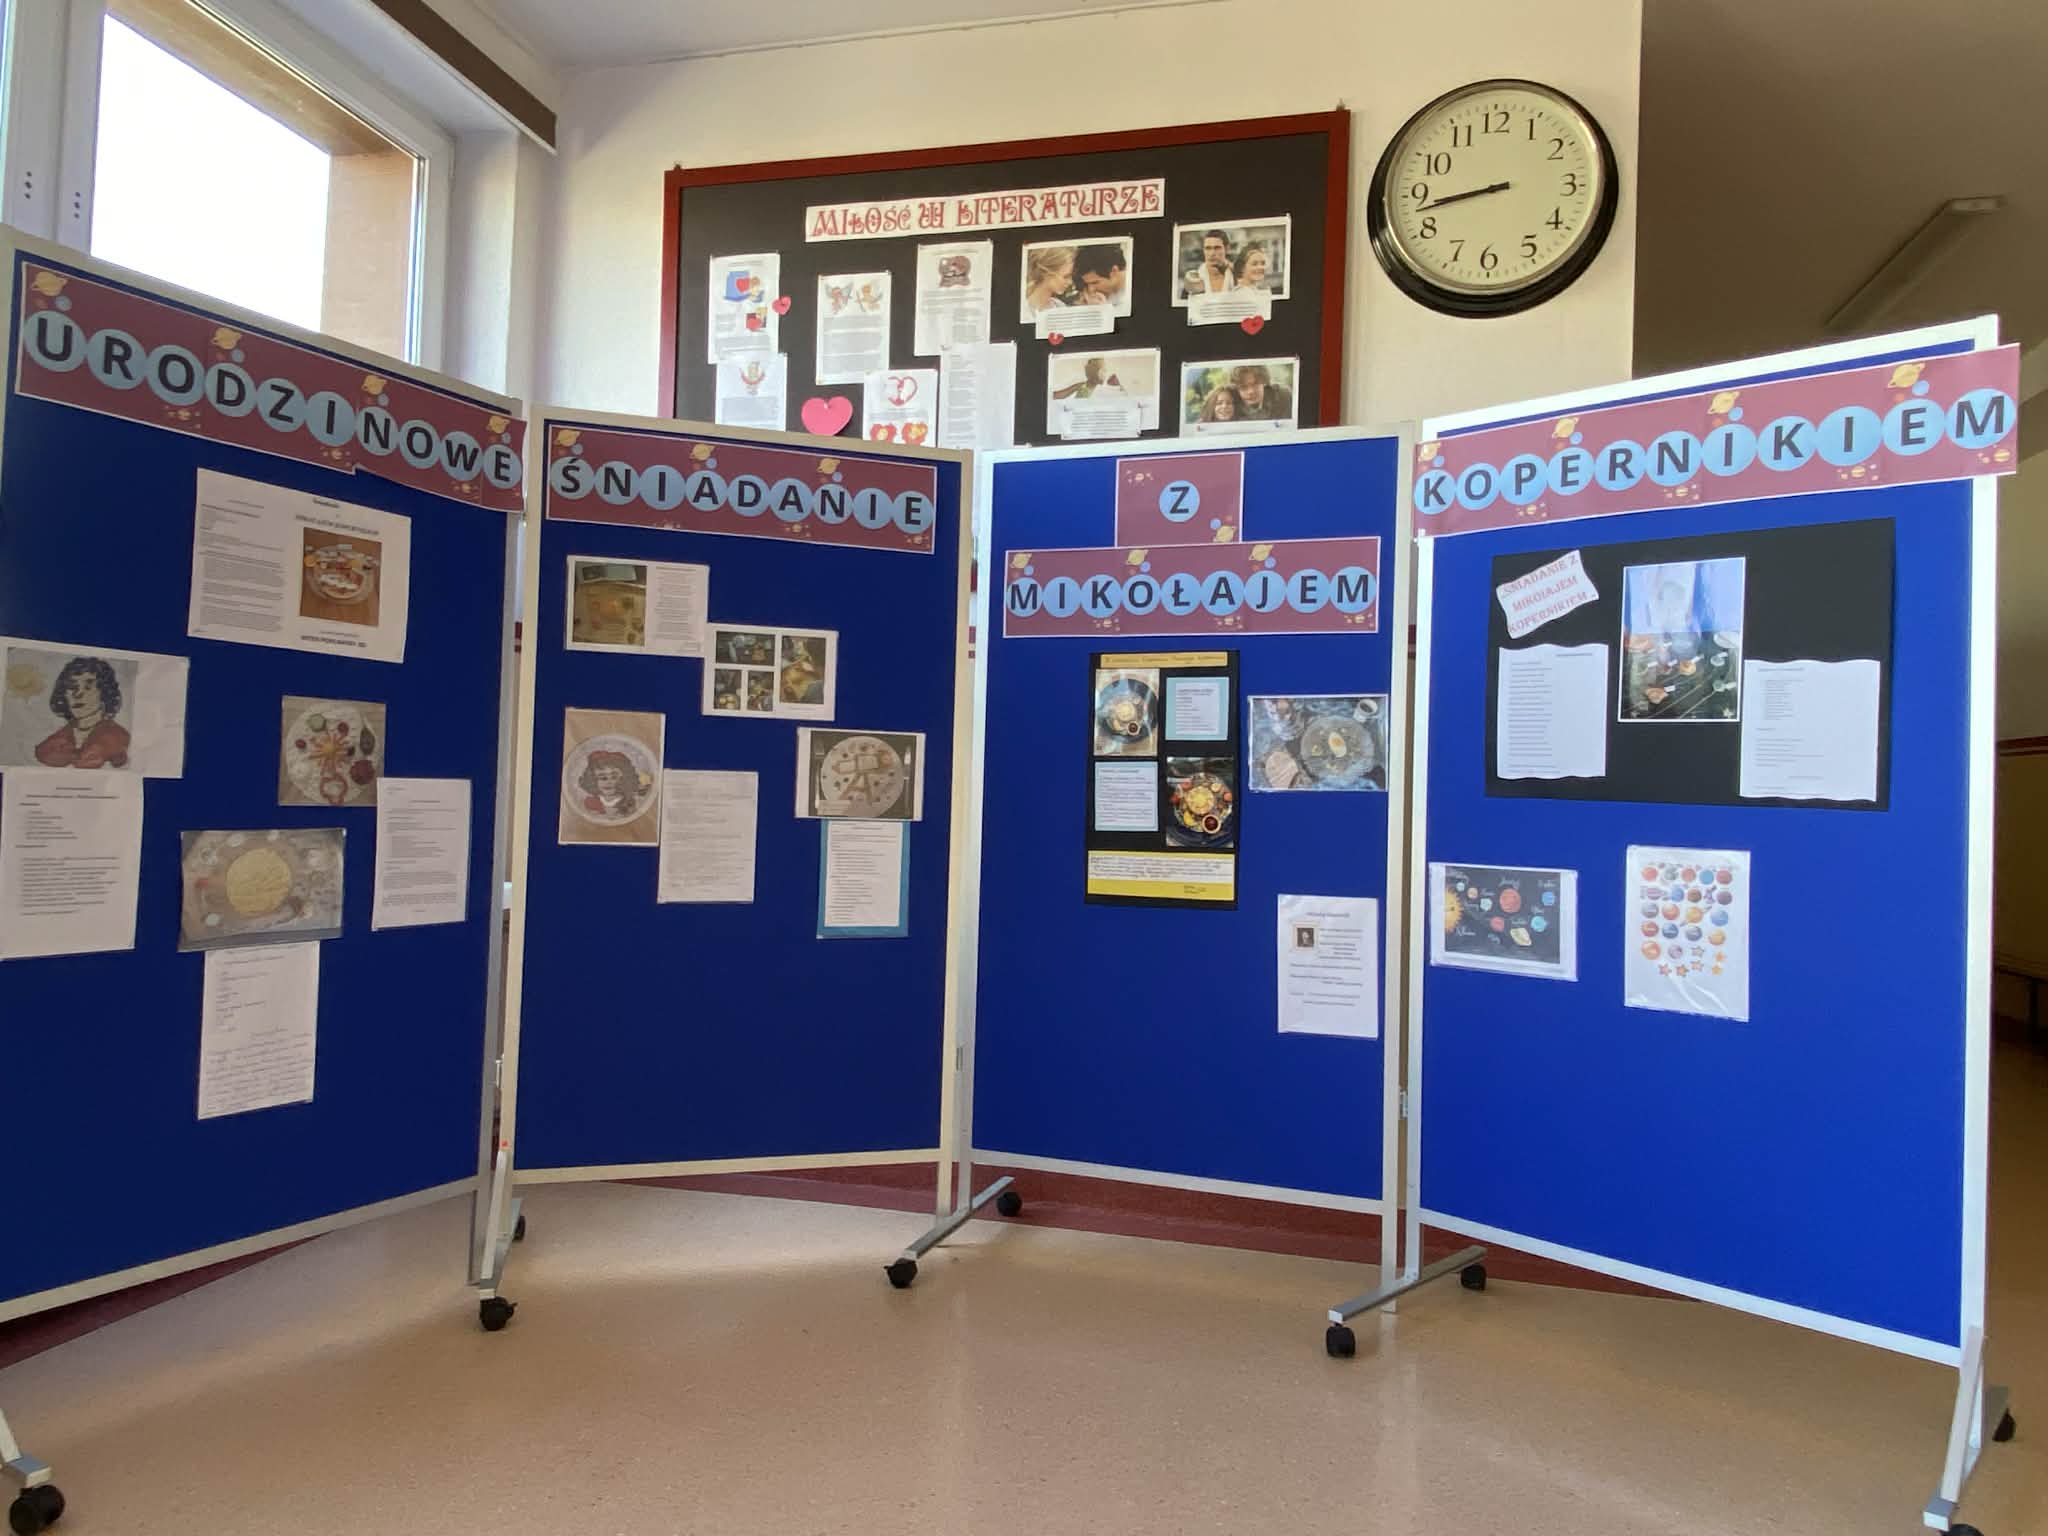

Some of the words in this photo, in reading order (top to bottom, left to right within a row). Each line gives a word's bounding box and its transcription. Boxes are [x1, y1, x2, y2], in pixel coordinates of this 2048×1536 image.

[1481, 111, 1510, 134] 12
[1527, 118, 1537, 141] 1
[1451, 124, 1474, 148] 11
[1547, 138, 1565, 160] 2
[1424, 151, 1452, 176] 10
[1411, 182, 1429, 207] 9
[1560, 173, 1577, 197] 3
[956, 183, 1161, 228] LITERATURZE
[1420, 216, 1437, 239] 8
[1545, 207, 1564, 230] 4
[1450, 239, 1466, 262] 7
[1480, 245, 1498, 271] 6
[1520, 234, 1538, 258] 5
[35, 317, 512, 483] URODZINOWE
[1422, 395, 2006, 510] KOPERNIKIEM
[560, 457, 923, 526] ŚNIADANIE
[1168, 485, 1191, 515] Z
[1010, 573, 1370, 611] MIKOŁAJEM
